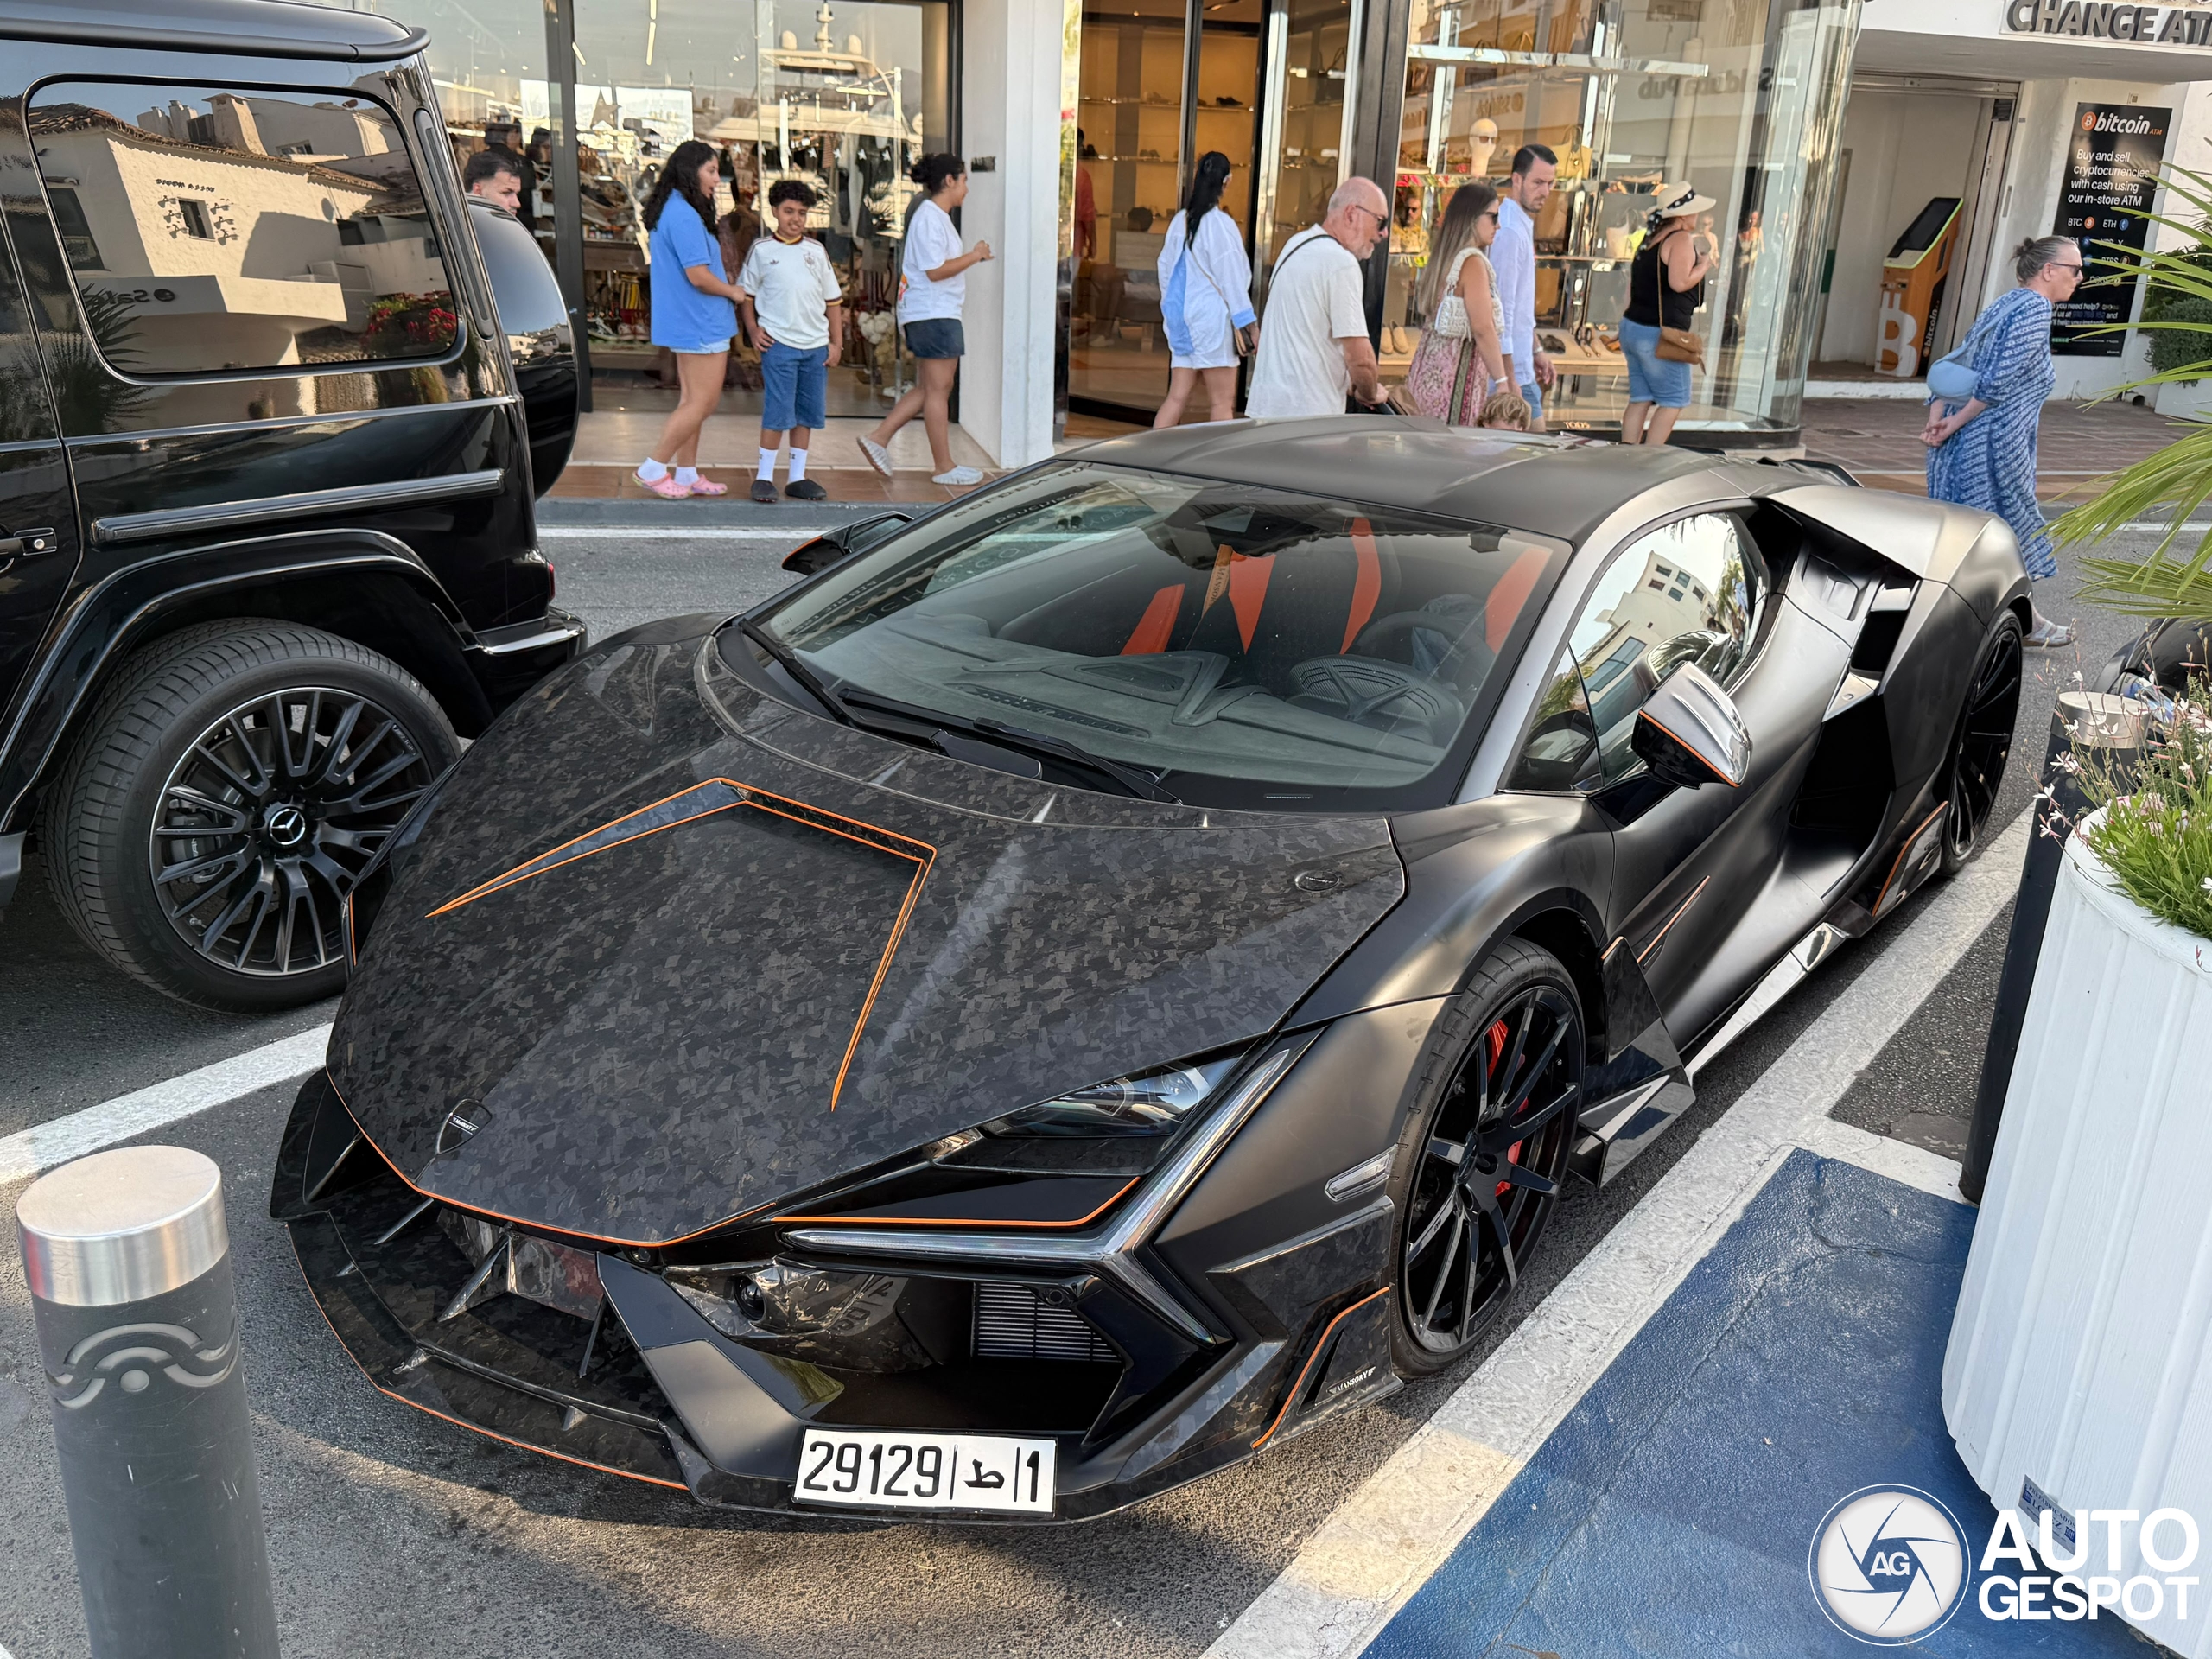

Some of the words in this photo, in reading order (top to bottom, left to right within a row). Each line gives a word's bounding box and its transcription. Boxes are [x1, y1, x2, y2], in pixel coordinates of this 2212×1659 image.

[2006, 0, 2159, 41] CHANGE
[2157, 10, 2212, 47] AT
[2094, 112, 2151, 135] bitcoin
[2076, 149, 2094, 162] Buy
[2095, 151, 2114, 162] and
[2114, 152, 2131, 162] sell
[2073, 164, 2151, 178] cryptocurrencies
[2070, 178, 2090, 189] with
[2091, 181, 2113, 191] cash
[2114, 181, 2139, 194] using
[2068, 194, 2084, 204] our
[2084, 193, 2120, 206] in-store
[2120, 194, 2143, 207] ATM
[2068, 218, 2083, 227] BTC
[2102, 219, 2117, 228] ETH
[2068, 302, 2083, 311] need
[2083, 302, 2101, 312] help?
[1924, 308, 1938, 347] bitcoin
[1337, 1370, 1371, 1392] MANSORY
[803, 1440, 943, 1497] 29129
[963, 1459, 1005, 1488] ط
[1027, 1450, 1039, 1503] 1
